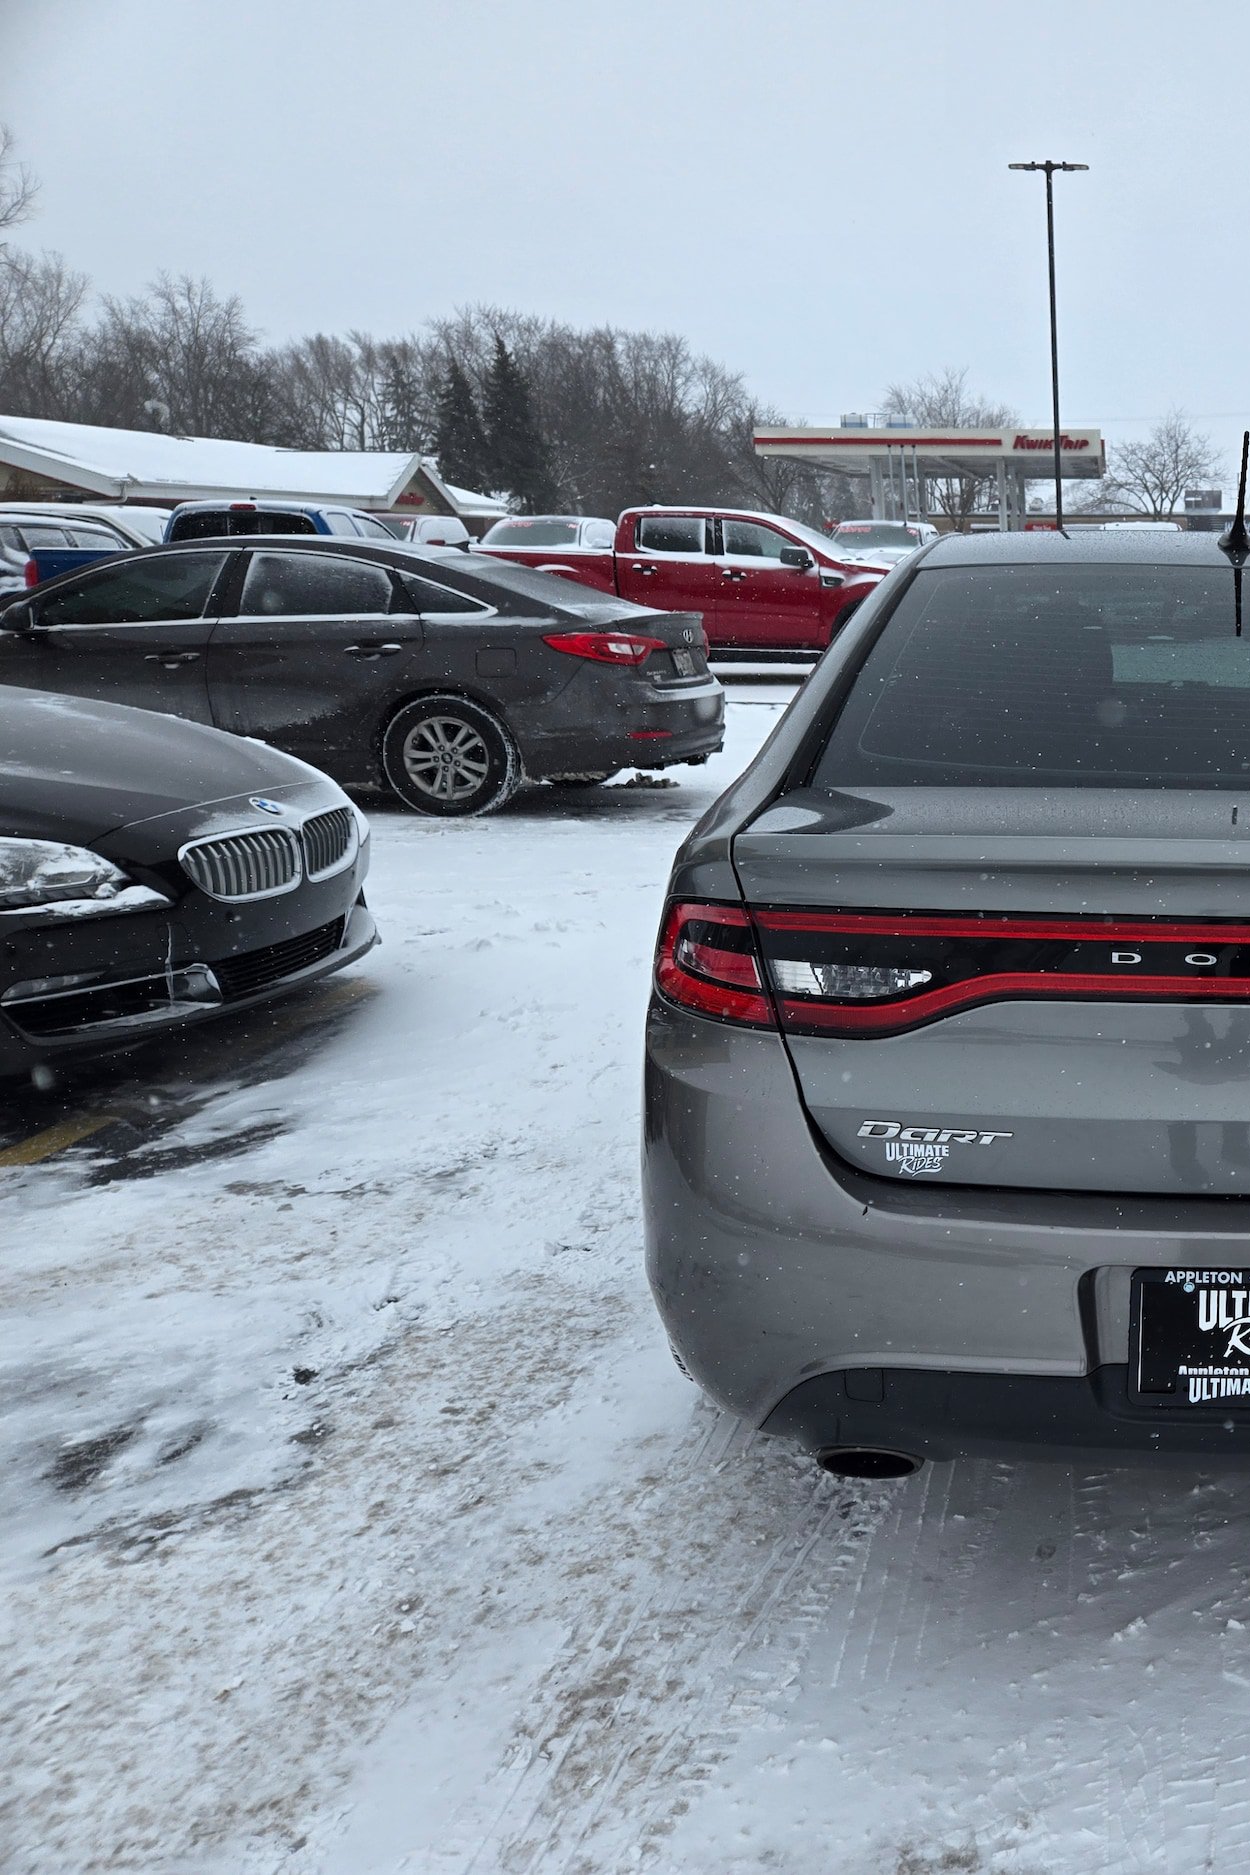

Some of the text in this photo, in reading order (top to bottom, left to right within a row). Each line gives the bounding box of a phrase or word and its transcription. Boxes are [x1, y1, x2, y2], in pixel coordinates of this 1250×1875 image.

[1013, 434, 1055, 449] KWIK
[886, 1142, 949, 1162] ULTIMATE
[1165, 1271, 1243, 1284] APPLETON
